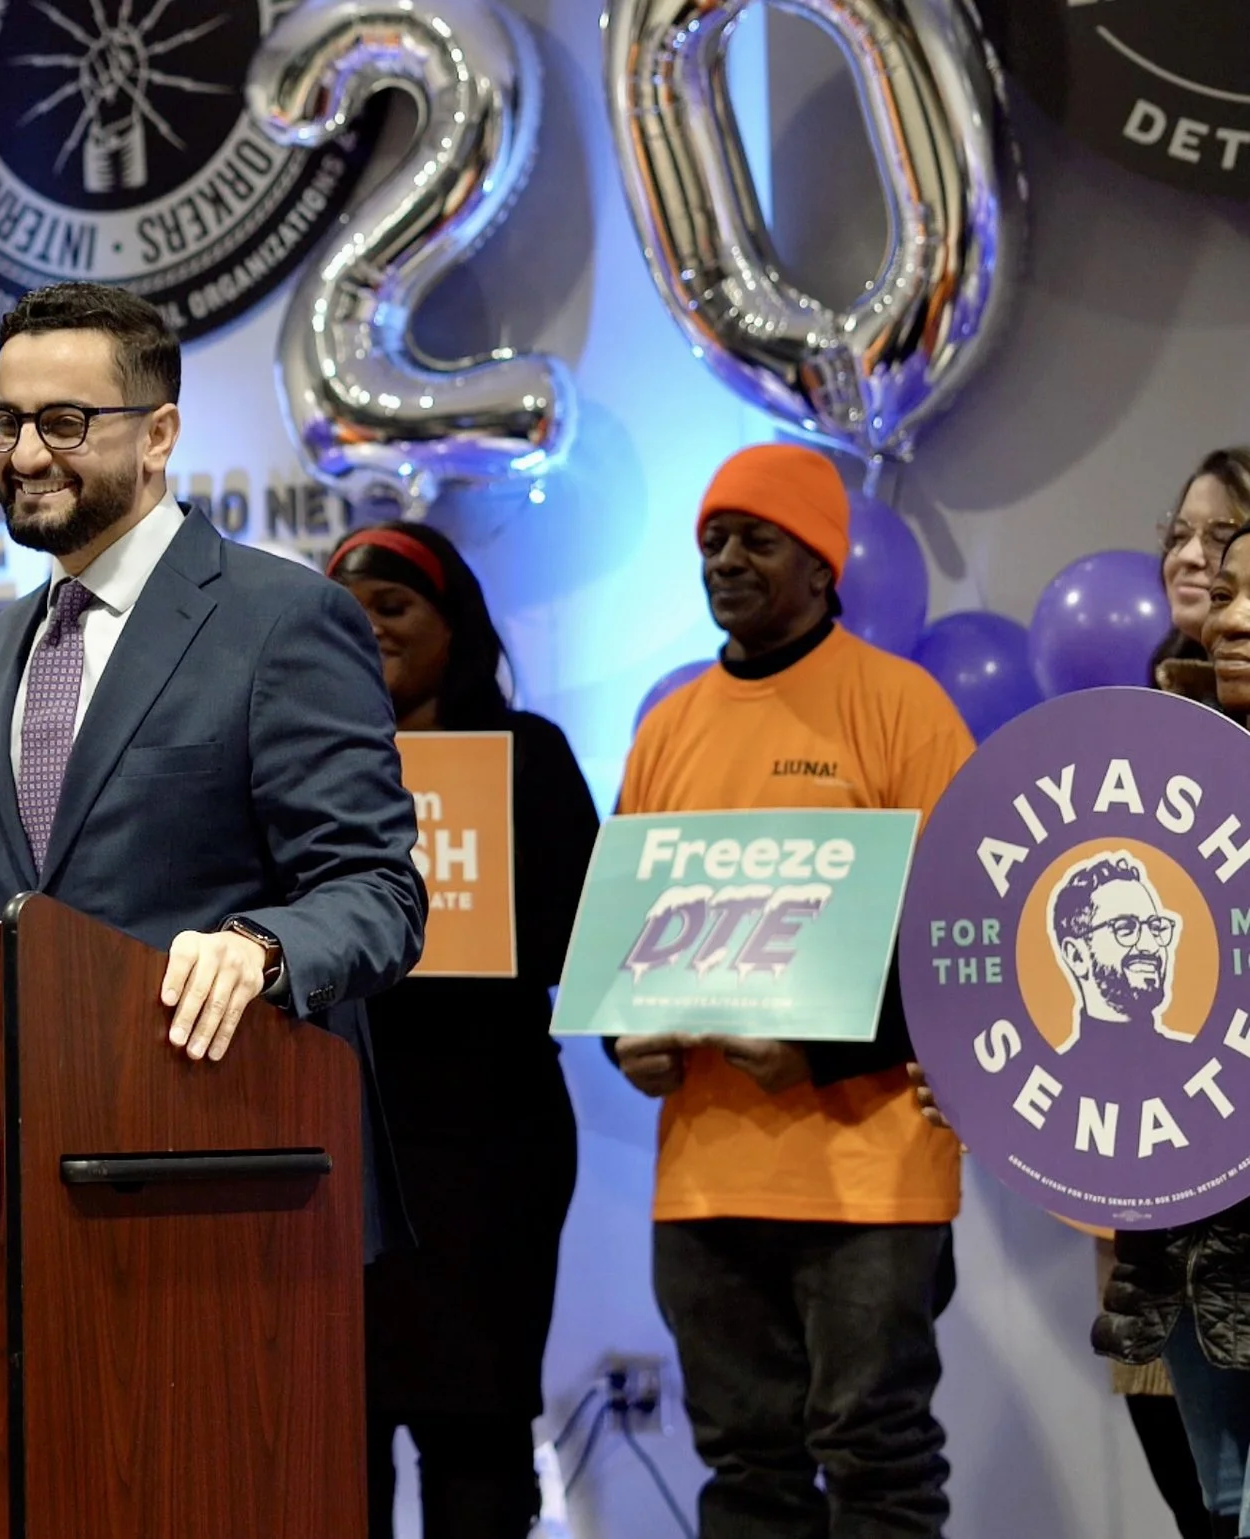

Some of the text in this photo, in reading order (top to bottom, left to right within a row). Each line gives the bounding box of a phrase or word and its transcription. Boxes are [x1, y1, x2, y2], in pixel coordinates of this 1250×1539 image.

[136, 136, 274, 265] ORKERS
[636, 827, 855, 880] Freeze
[975, 758, 1250, 898] AIYASH
[617, 882, 833, 982] DTE
[930, 918, 1001, 947] FOR
[932, 956, 1003, 985] THE
[1008, 1154, 1041, 1180] ABRAHAM
[1041, 1176, 1067, 1193] AIYASH
[1067, 1187, 1082, 1199] FOR
[1083, 1192, 1107, 1205] STATE
[1108, 1196, 1137, 1207] SENATE
[1154, 1195, 1171, 1205] BOX
[1197, 1173, 1228, 1194] DETROIT
[1227, 1167, 1239, 1178] MI
